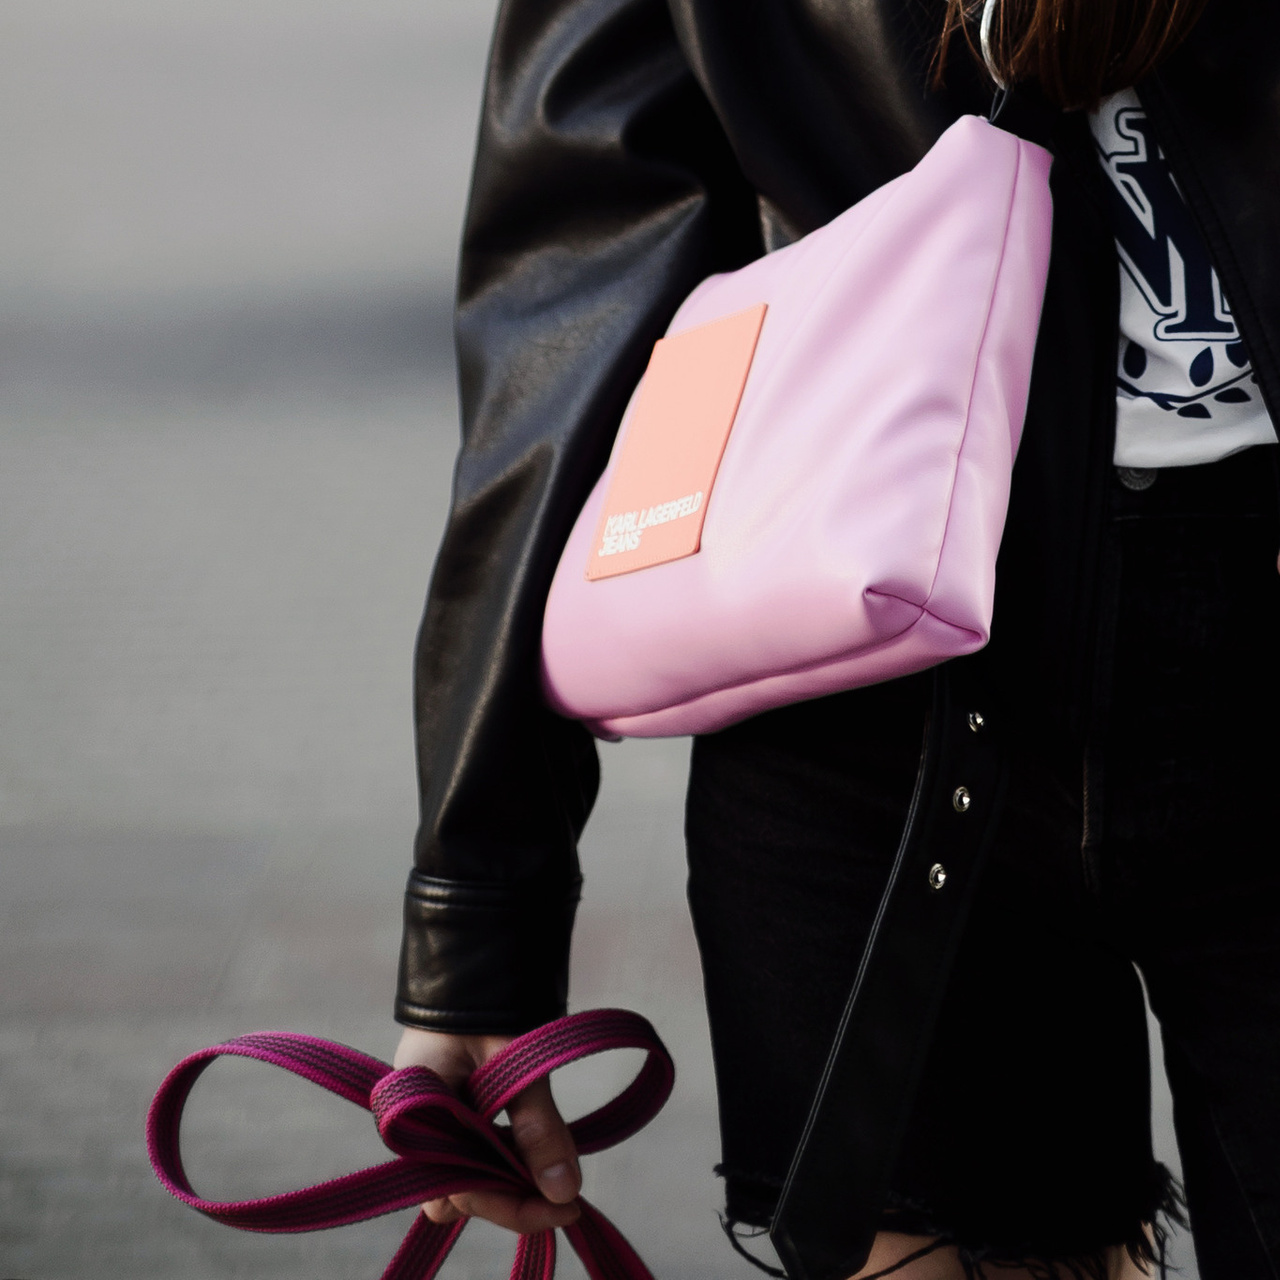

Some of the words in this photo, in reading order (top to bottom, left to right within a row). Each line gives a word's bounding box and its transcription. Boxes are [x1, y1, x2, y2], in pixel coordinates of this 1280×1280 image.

[603, 510, 638, 537] KARL
[637, 491, 703, 530] LAGERFELD
[598, 530, 643, 557] JEANS
